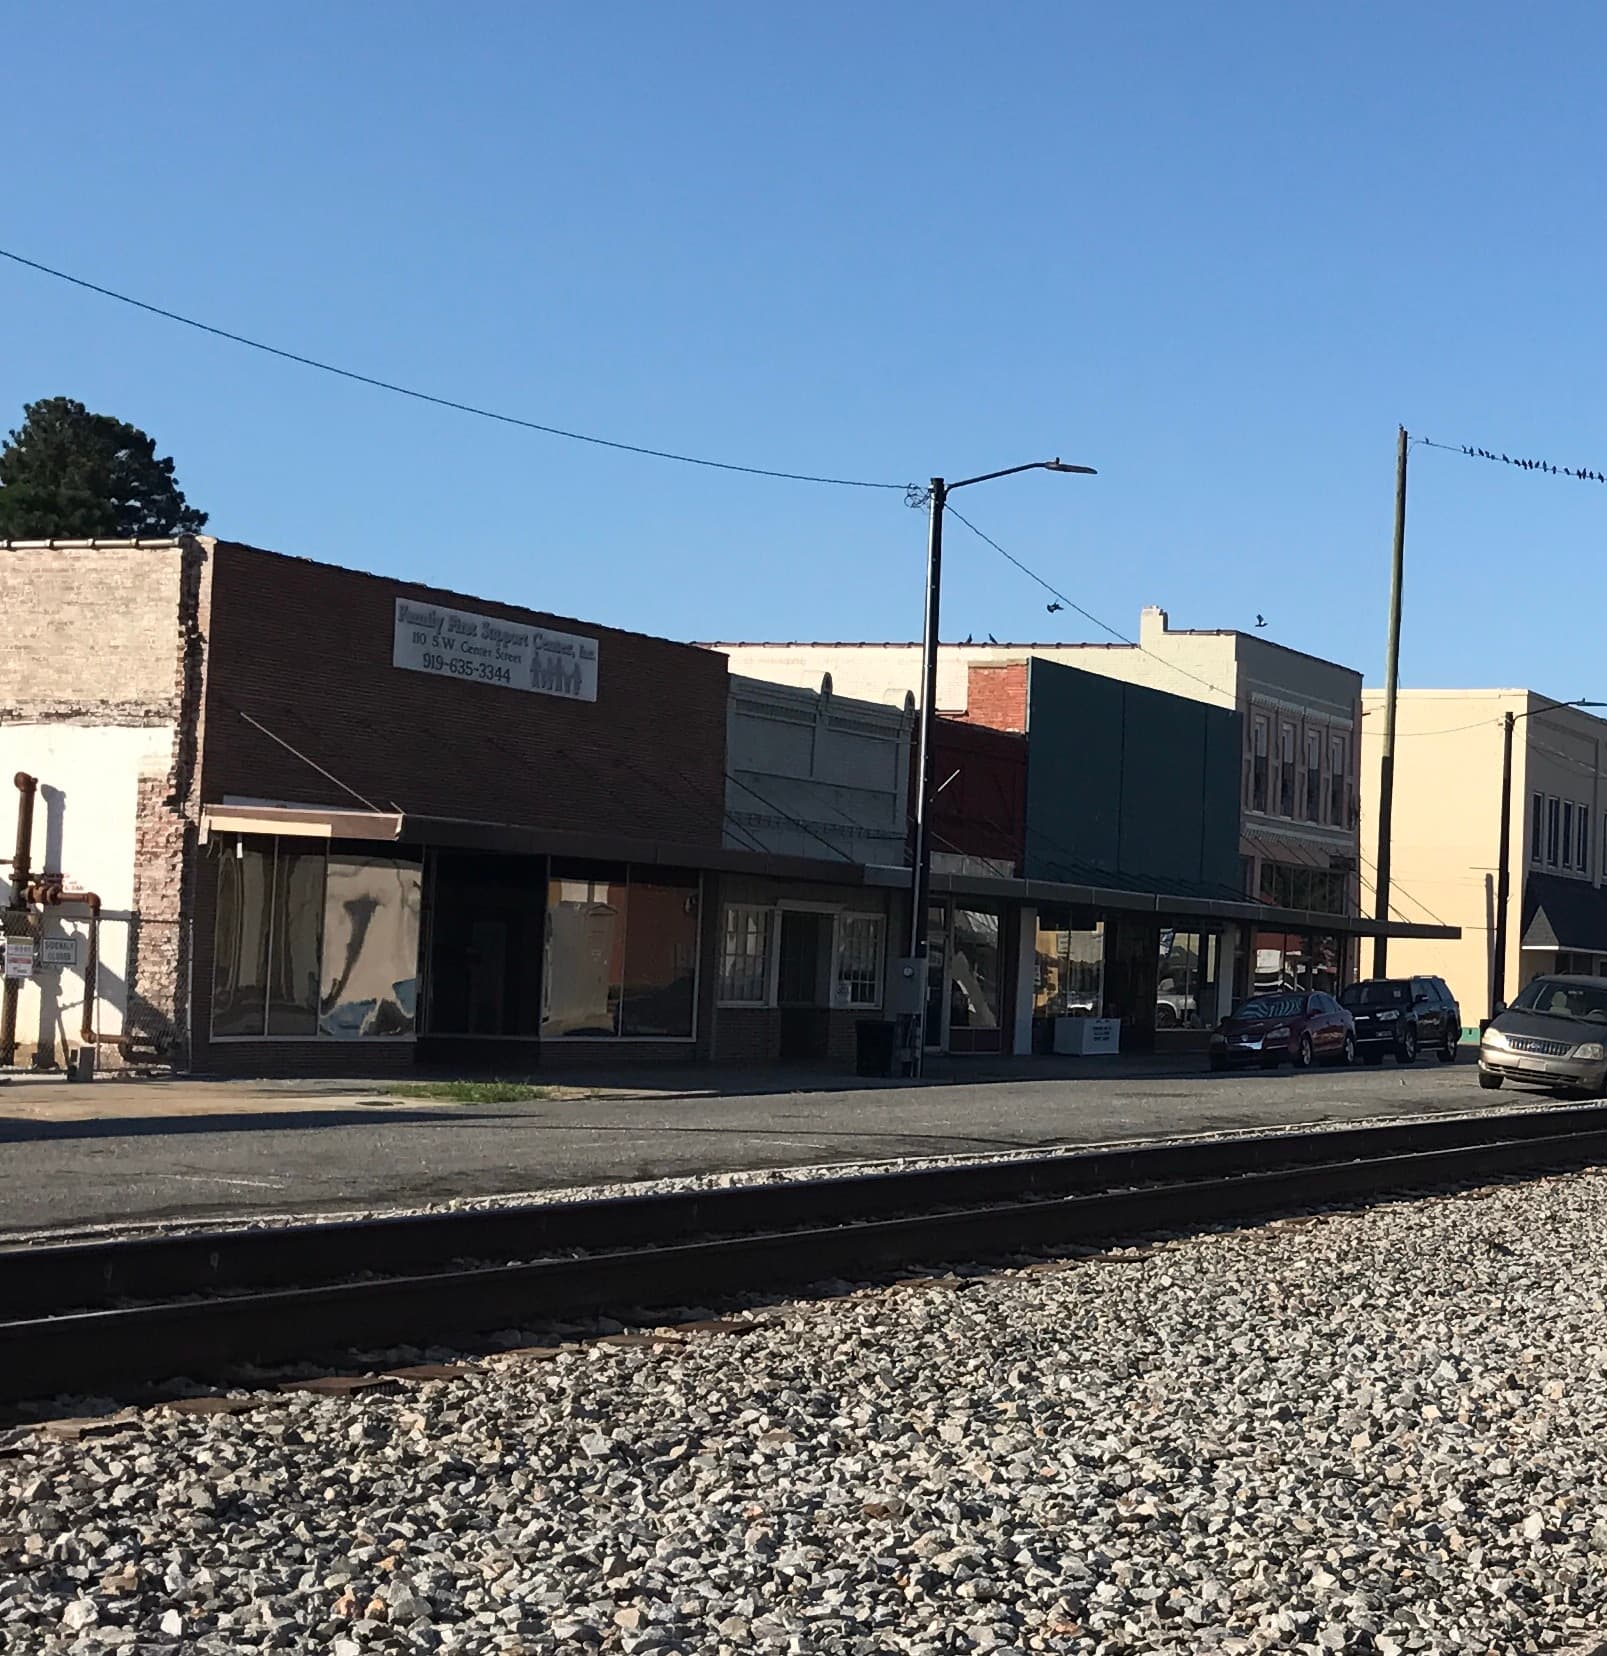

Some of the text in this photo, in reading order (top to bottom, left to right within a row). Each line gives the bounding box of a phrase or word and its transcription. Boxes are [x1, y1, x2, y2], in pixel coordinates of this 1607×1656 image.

[398, 605, 444, 635] Family
[448, 615, 477, 637] First
[481, 622, 529, 648] Support
[412, 632, 427, 645] 110
[461, 641, 492, 657] Center
[495, 648, 522, 664] Street
[423, 653, 511, 684] 919-635-3344
